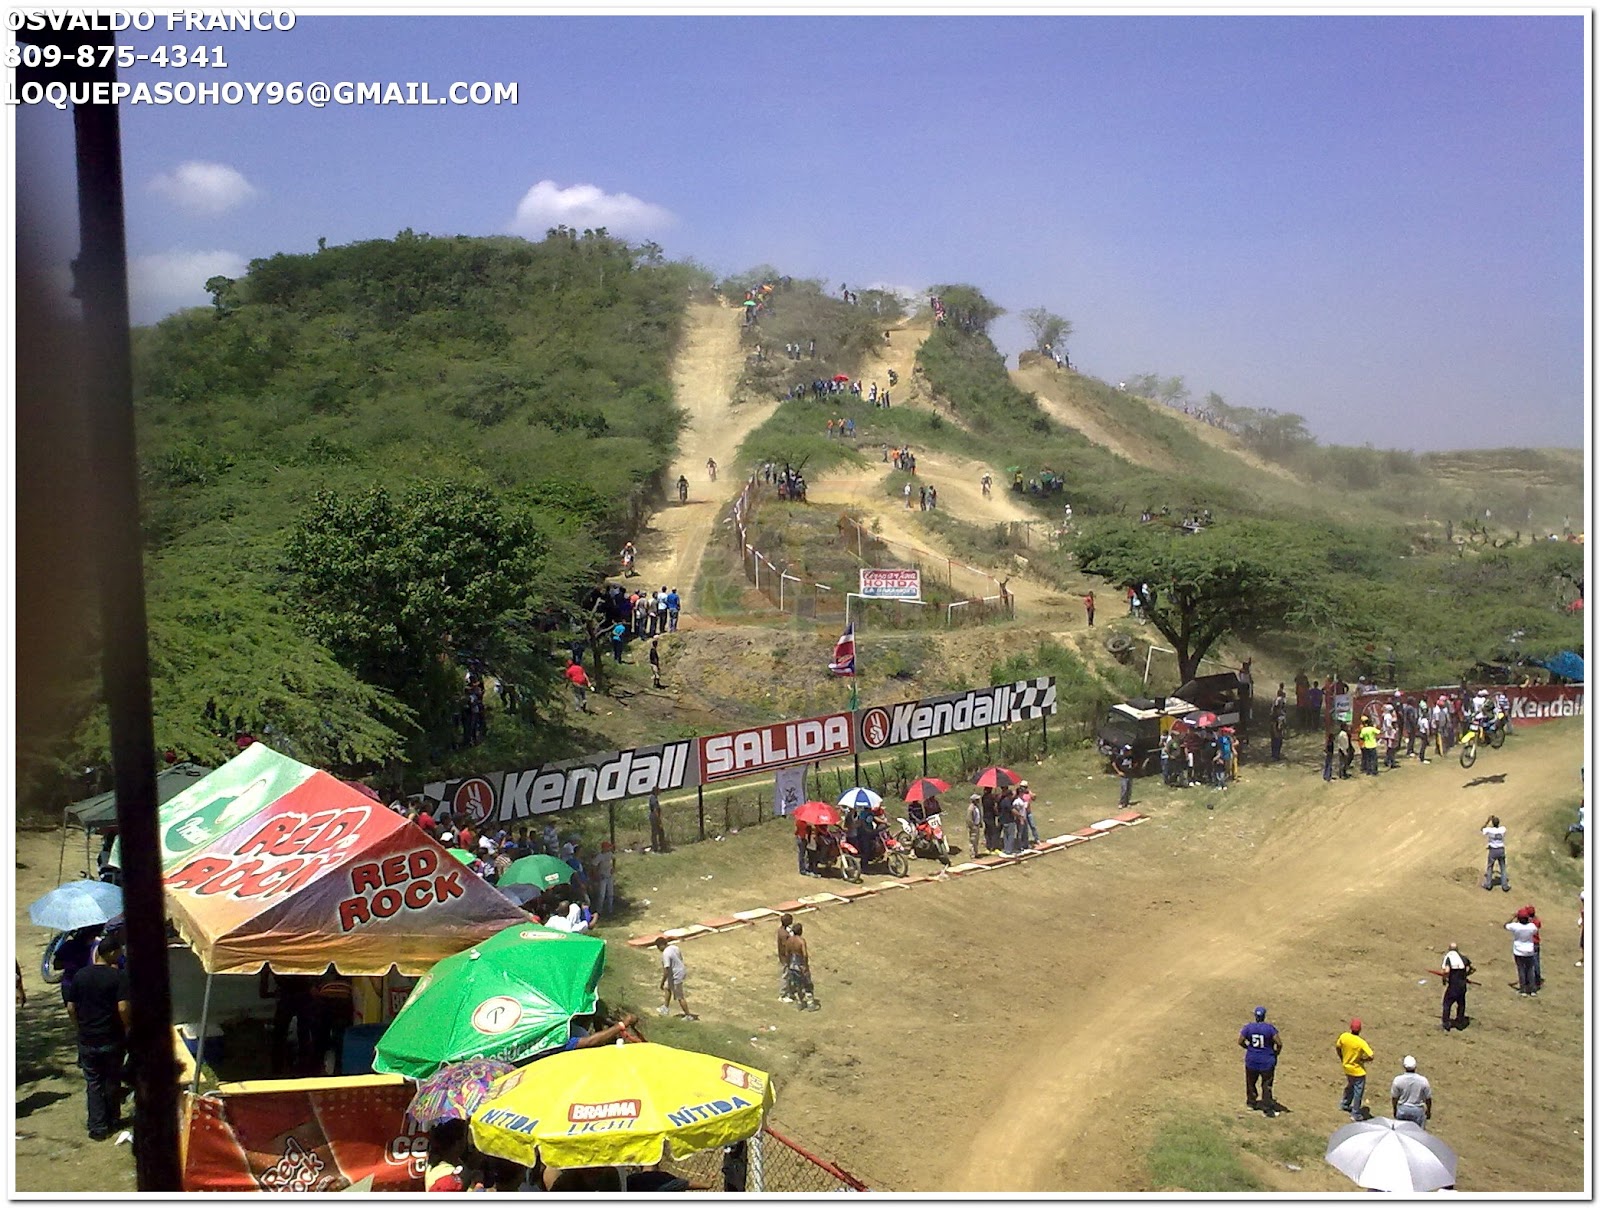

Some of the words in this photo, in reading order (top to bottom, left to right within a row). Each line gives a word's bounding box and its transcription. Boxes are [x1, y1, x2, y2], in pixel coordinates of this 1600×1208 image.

[889, 687, 1010, 744] Kendall
[1511, 693, 1585, 718] Kendall
[706, 716, 850, 774] SALIDA
[500, 742, 690, 822] Kendall
[234, 811, 366, 856] RED
[351, 849, 437, 894] RED
[338, 871, 464, 932] ROCK
[1251, 1033, 1265, 1048] 51
[566, 1119, 635, 1136] LIGHT
[571, 1103, 637, 1119] BRAHMA
[668, 1096, 752, 1127] NÍTIDA
